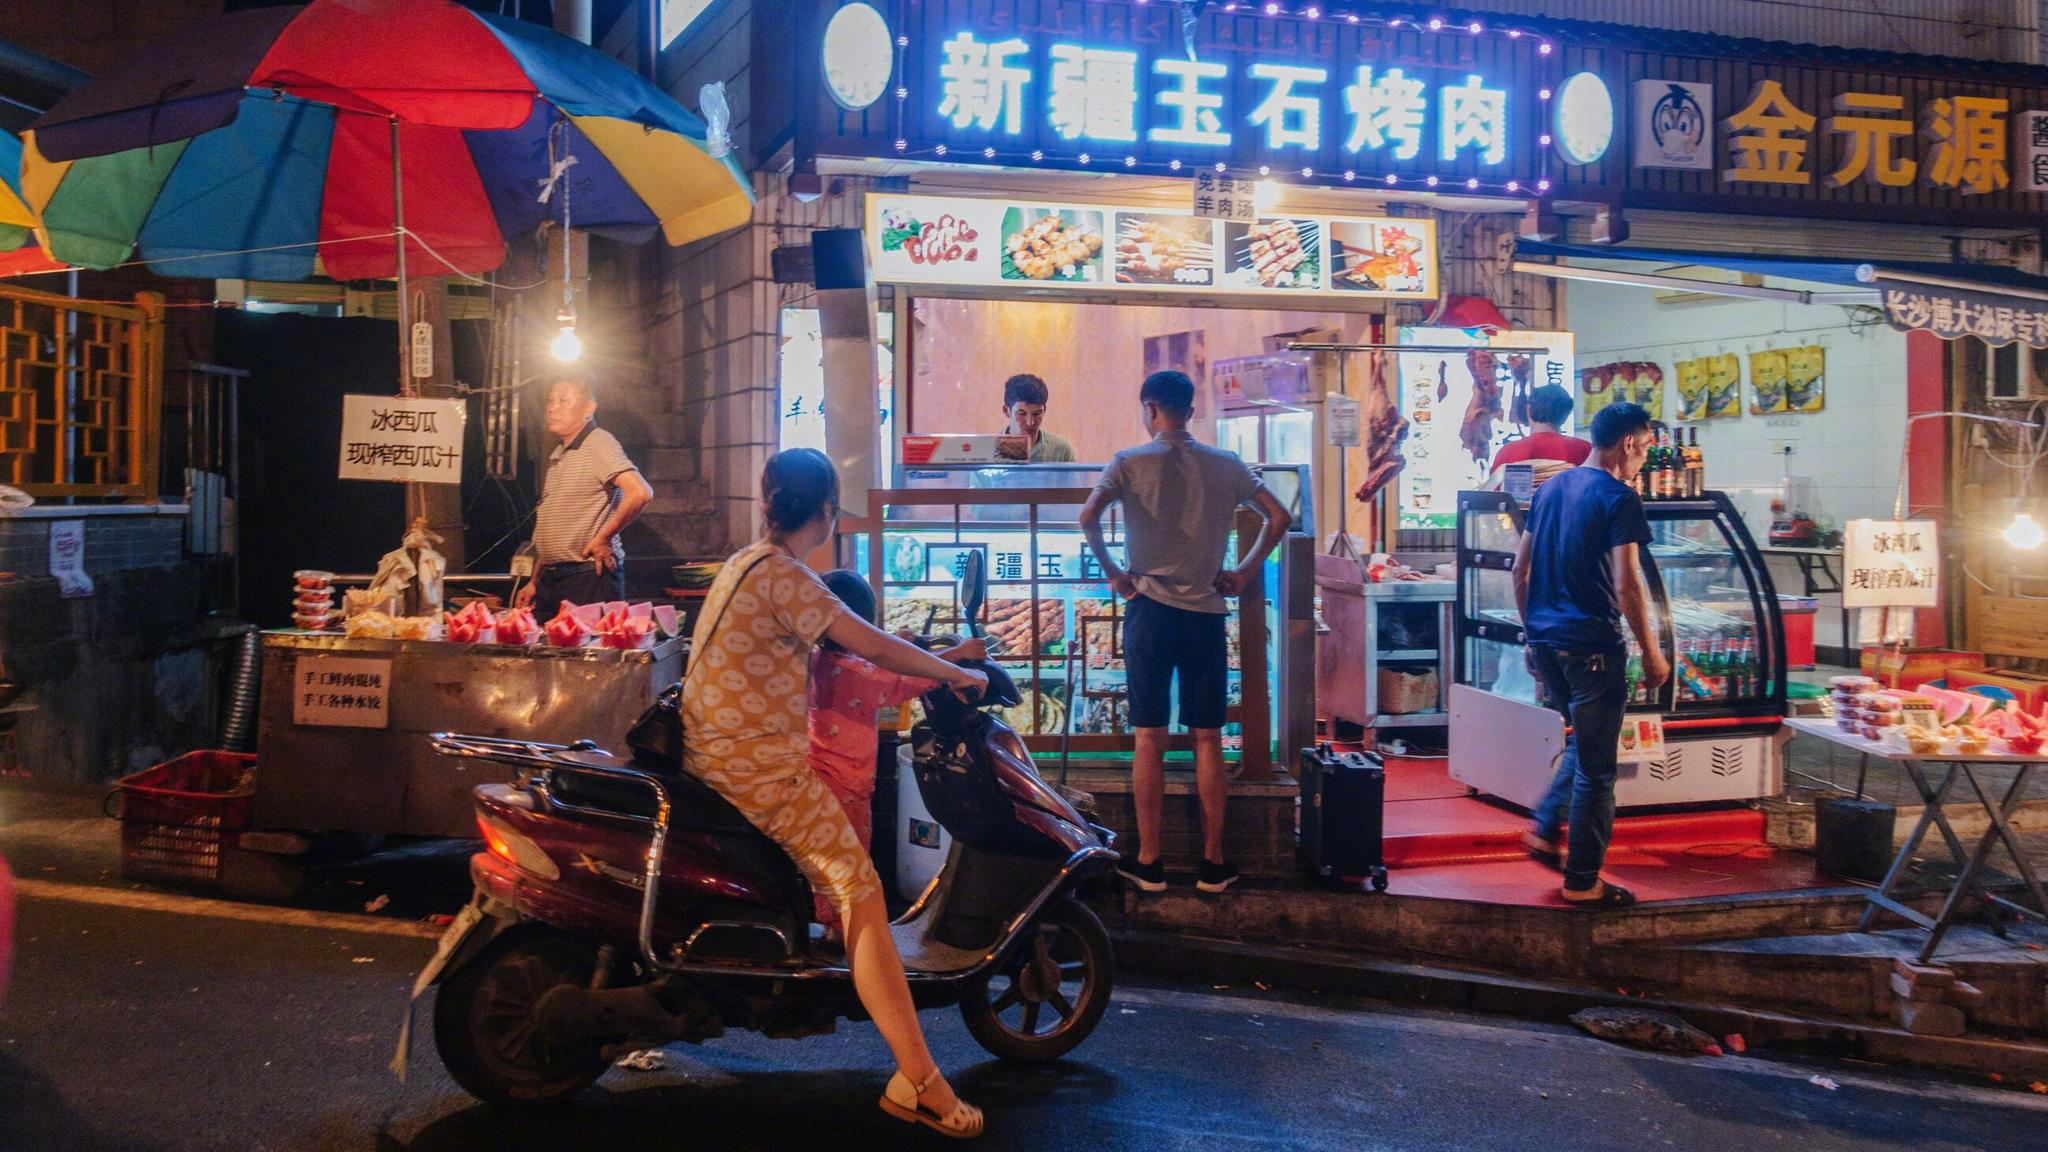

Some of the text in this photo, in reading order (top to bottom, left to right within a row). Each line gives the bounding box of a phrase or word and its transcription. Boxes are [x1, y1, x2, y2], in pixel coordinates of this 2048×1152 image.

[937, 31, 1508, 165] 新疆玉石烤肉
[1725, 79, 2010, 194] 金元源
[1197, 195, 1254, 218] 羊肉汤
[370, 408, 438, 433] 冰西瓜
[346, 442, 460, 469] 现榨西瓜汁
[955, 551, 1128, 580] 新疆玉石
